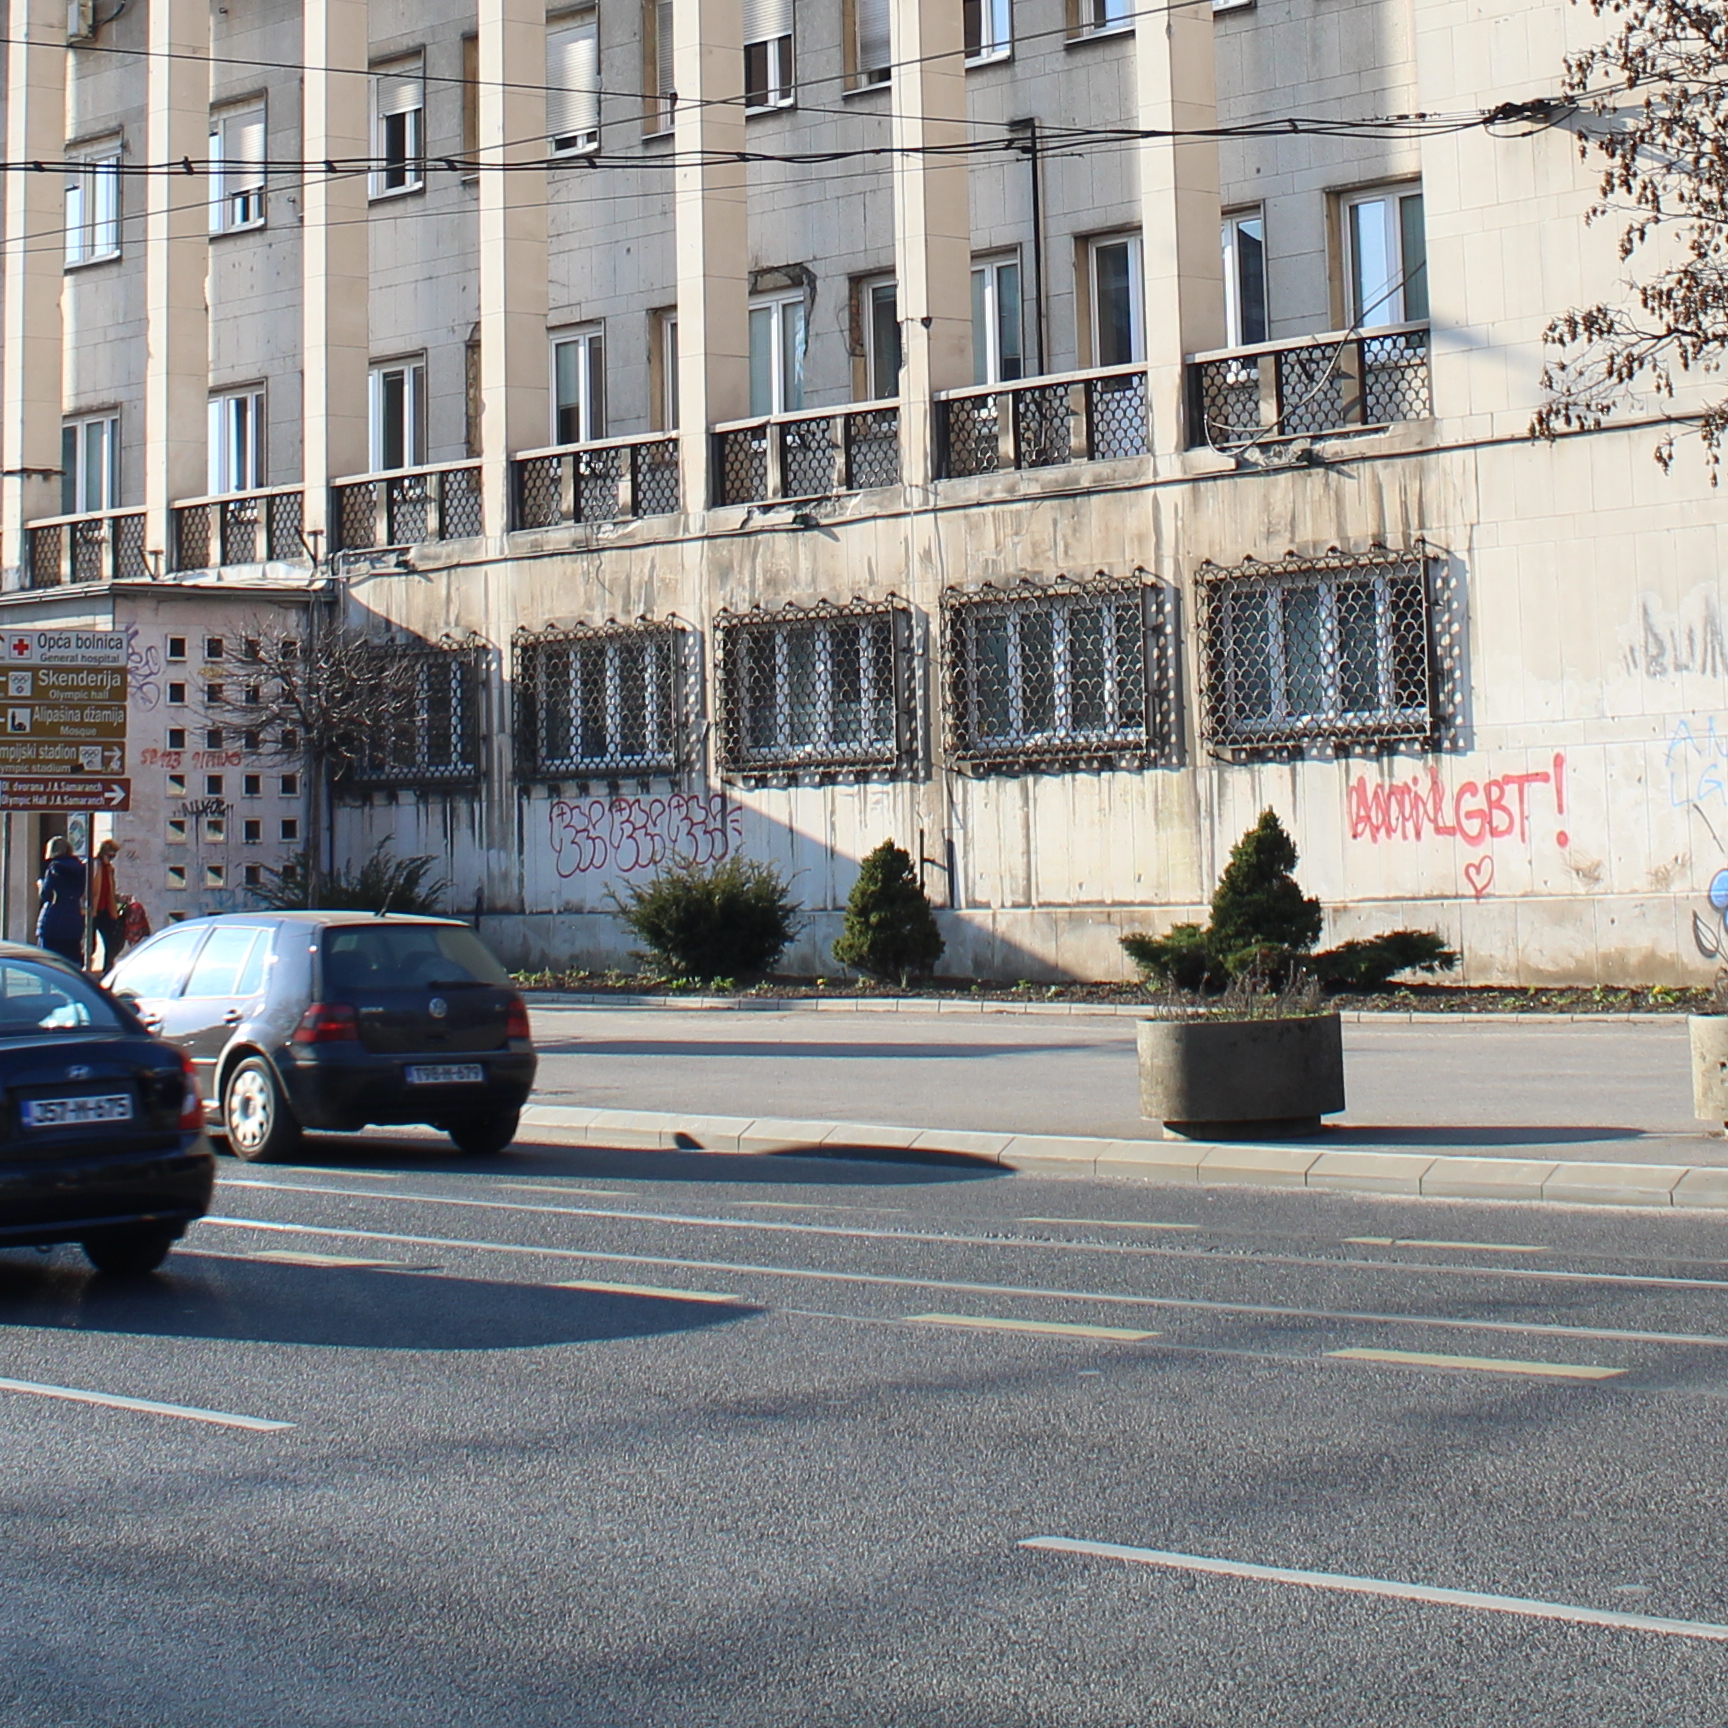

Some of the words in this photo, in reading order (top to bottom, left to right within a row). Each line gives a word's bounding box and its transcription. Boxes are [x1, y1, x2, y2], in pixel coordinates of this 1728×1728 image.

[37, 632, 71, 651] Opća
[76, 633, 124, 650] bolnica
[40, 652, 79, 663] General
[80, 653, 120, 665] hospital
[38, 669, 121, 690] Skenderija
[49, 689, 89, 701] Olympic
[90, 689, 109, 699] hall
[33, 705, 81, 724] Alipašina
[83, 706, 125, 726] džamija
[60, 725, 97, 736] Mosque
[38, 744, 77, 759] stadion
[31, 762, 71, 773] stadium
[1, 795, 31, 806] Olympic
[32, 795, 47, 804] Hall
[35, 1096, 128, 1124] J57-M-675
